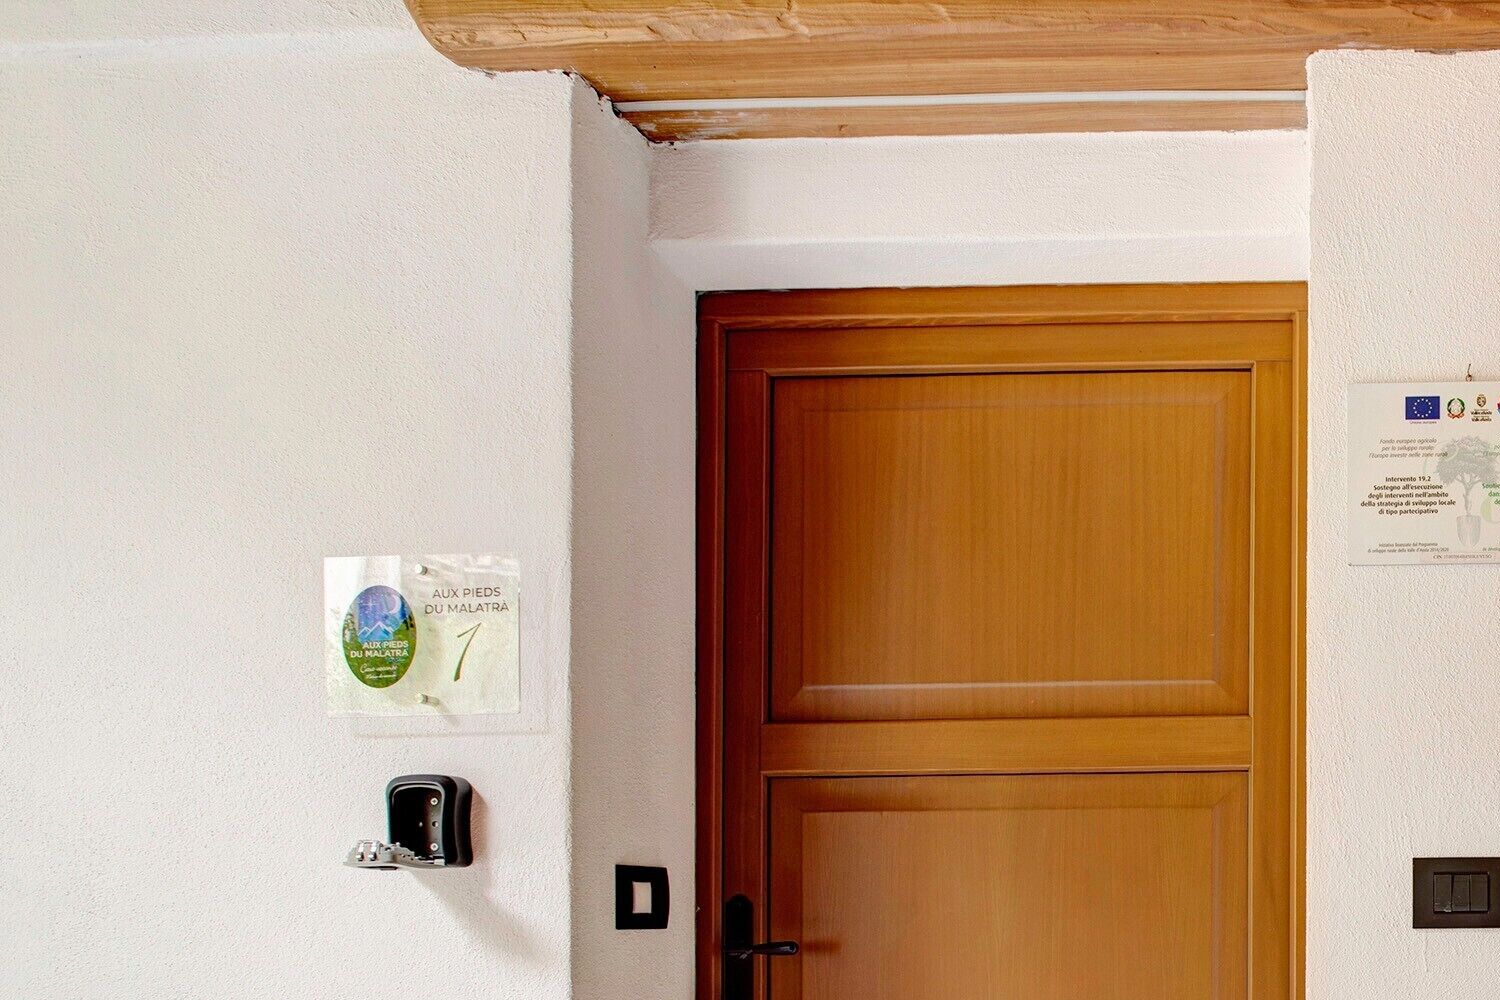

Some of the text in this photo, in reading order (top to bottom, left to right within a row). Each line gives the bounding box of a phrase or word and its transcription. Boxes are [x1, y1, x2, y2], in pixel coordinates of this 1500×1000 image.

[1377, 500, 1403, 508] strategia
[432, 587, 502, 599] AUX PIEDS
[424, 600, 510, 614] DU MALATRÀ
[383, 640, 409, 648] PIEDS
[350, 650, 363, 658] DU
[454, 622, 482, 682] 1
